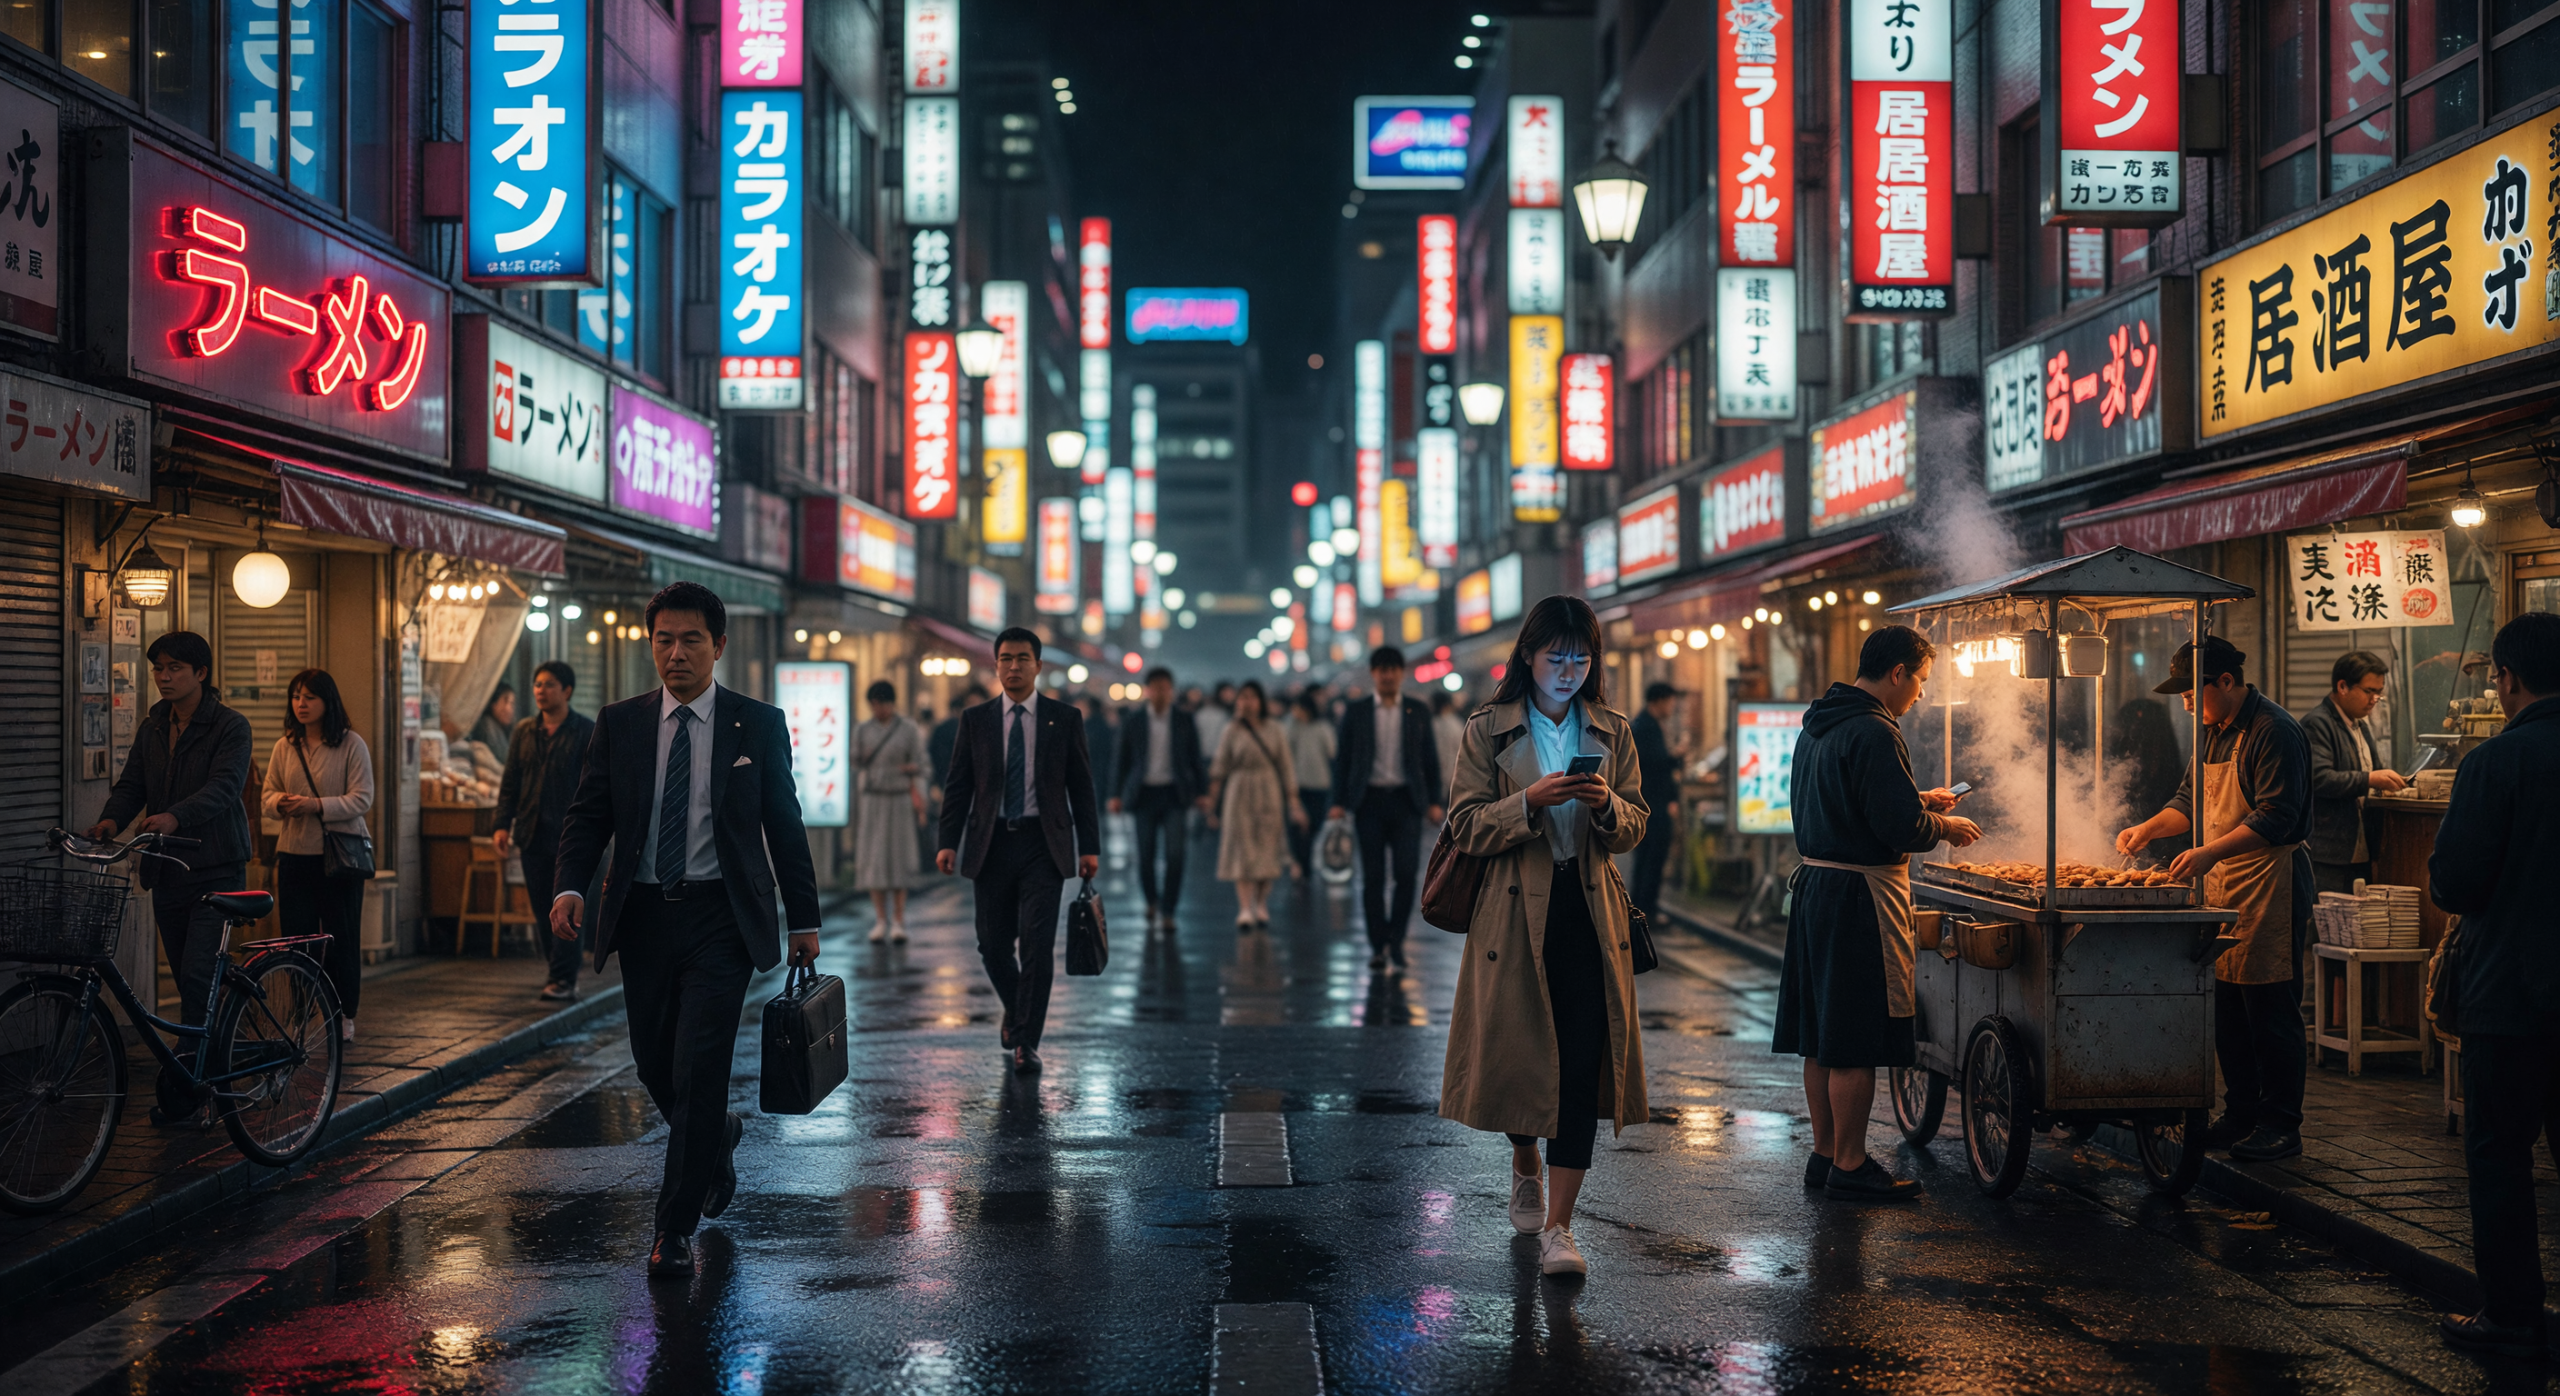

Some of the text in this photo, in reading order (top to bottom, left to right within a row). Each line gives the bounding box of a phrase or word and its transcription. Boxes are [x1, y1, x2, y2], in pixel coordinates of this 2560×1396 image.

[491, 0, 567, 253] ラオン
[733, 101, 790, 345] カラオケ
[1875, 90, 1929, 279] 居居酒屋
[176, 206, 428, 412] ラーメン
[2245, 198, 2457, 394] 居酒屋
[6, 399, 110, 467] ラーメン
[519, 372, 593, 463] ラーメン
